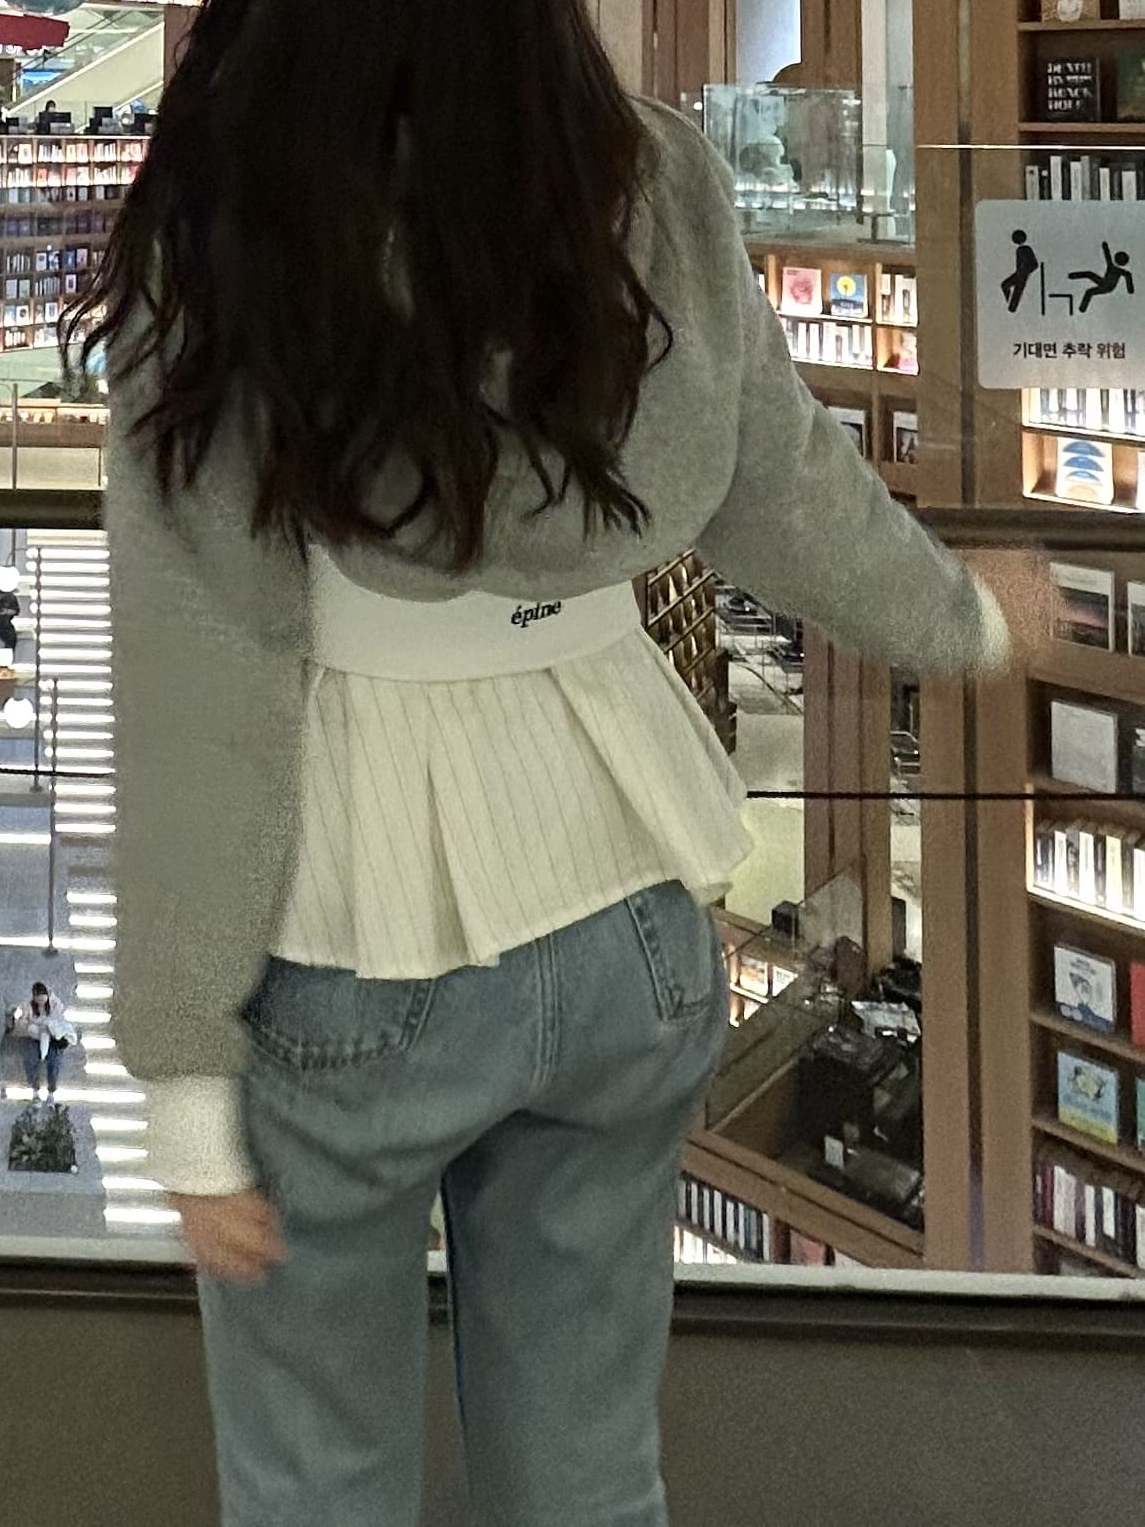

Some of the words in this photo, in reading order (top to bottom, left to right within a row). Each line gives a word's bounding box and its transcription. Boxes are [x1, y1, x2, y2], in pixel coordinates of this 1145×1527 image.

[1013, 342, 1058, 359] 기대면
[1062, 342, 1093, 359] 추락
[1097, 342, 1126, 359] 위험
